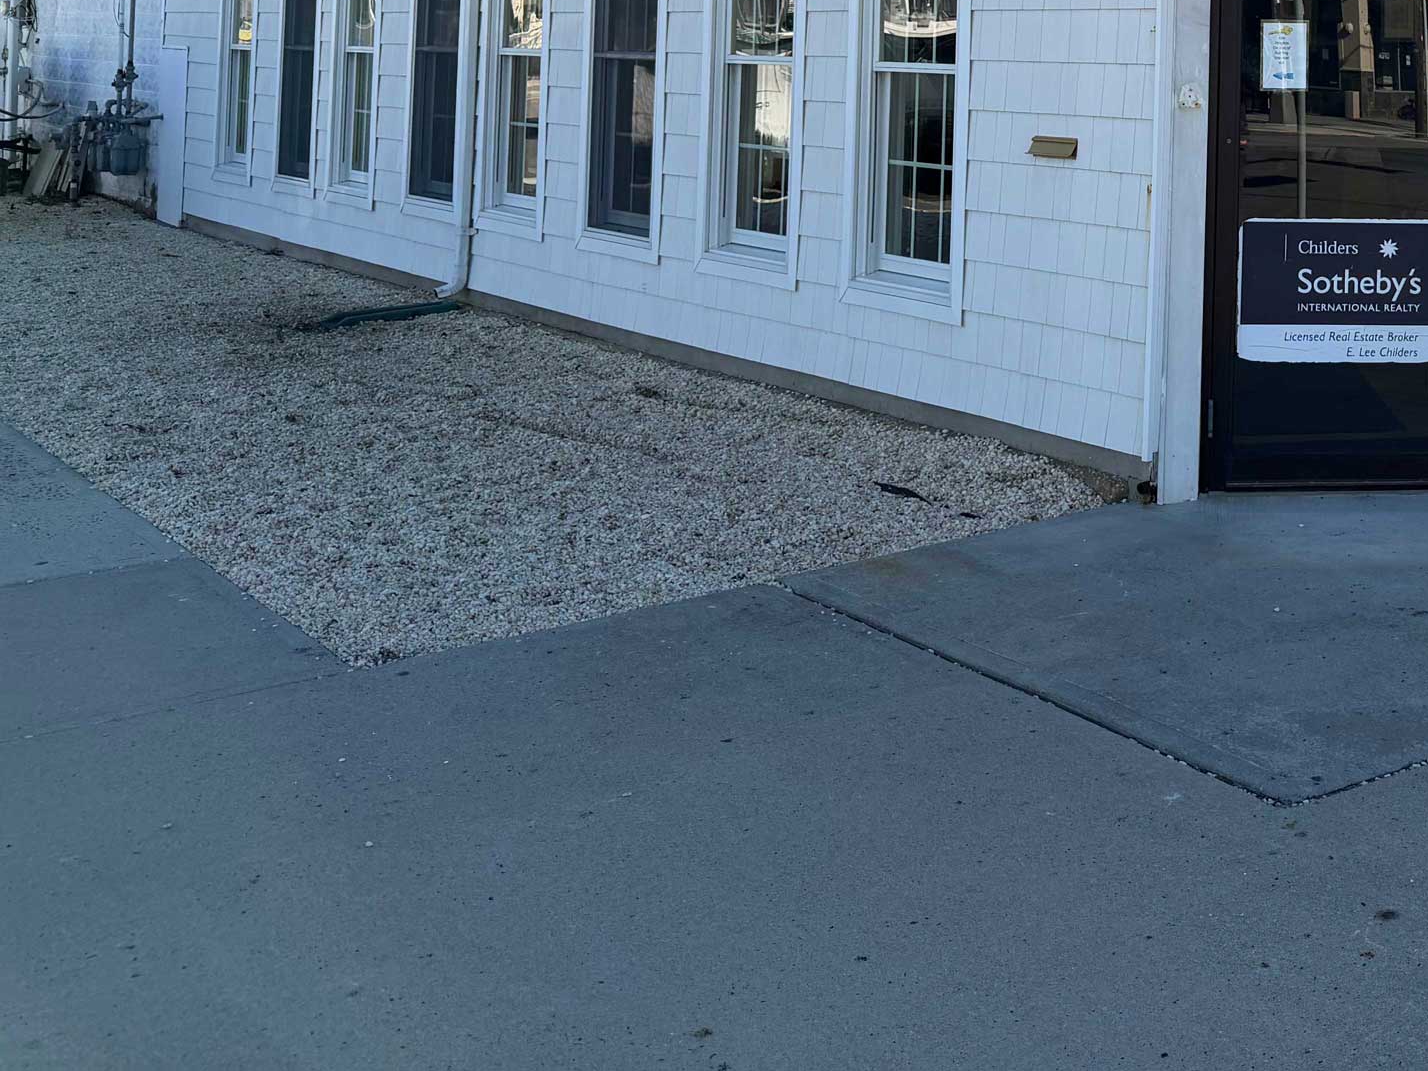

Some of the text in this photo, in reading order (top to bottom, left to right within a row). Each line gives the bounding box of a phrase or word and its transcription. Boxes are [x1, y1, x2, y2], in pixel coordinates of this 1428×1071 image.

[1298, 239, 1359, 255] Childers
[1297, 267, 1422, 302] Sotheby's
[1297, 303, 1421, 313] INTERNATIONAL REALTY
[1284, 331, 1418, 342] Licensed Real Estate Broker
[1346, 346, 1418, 357] E. Lee Childers
